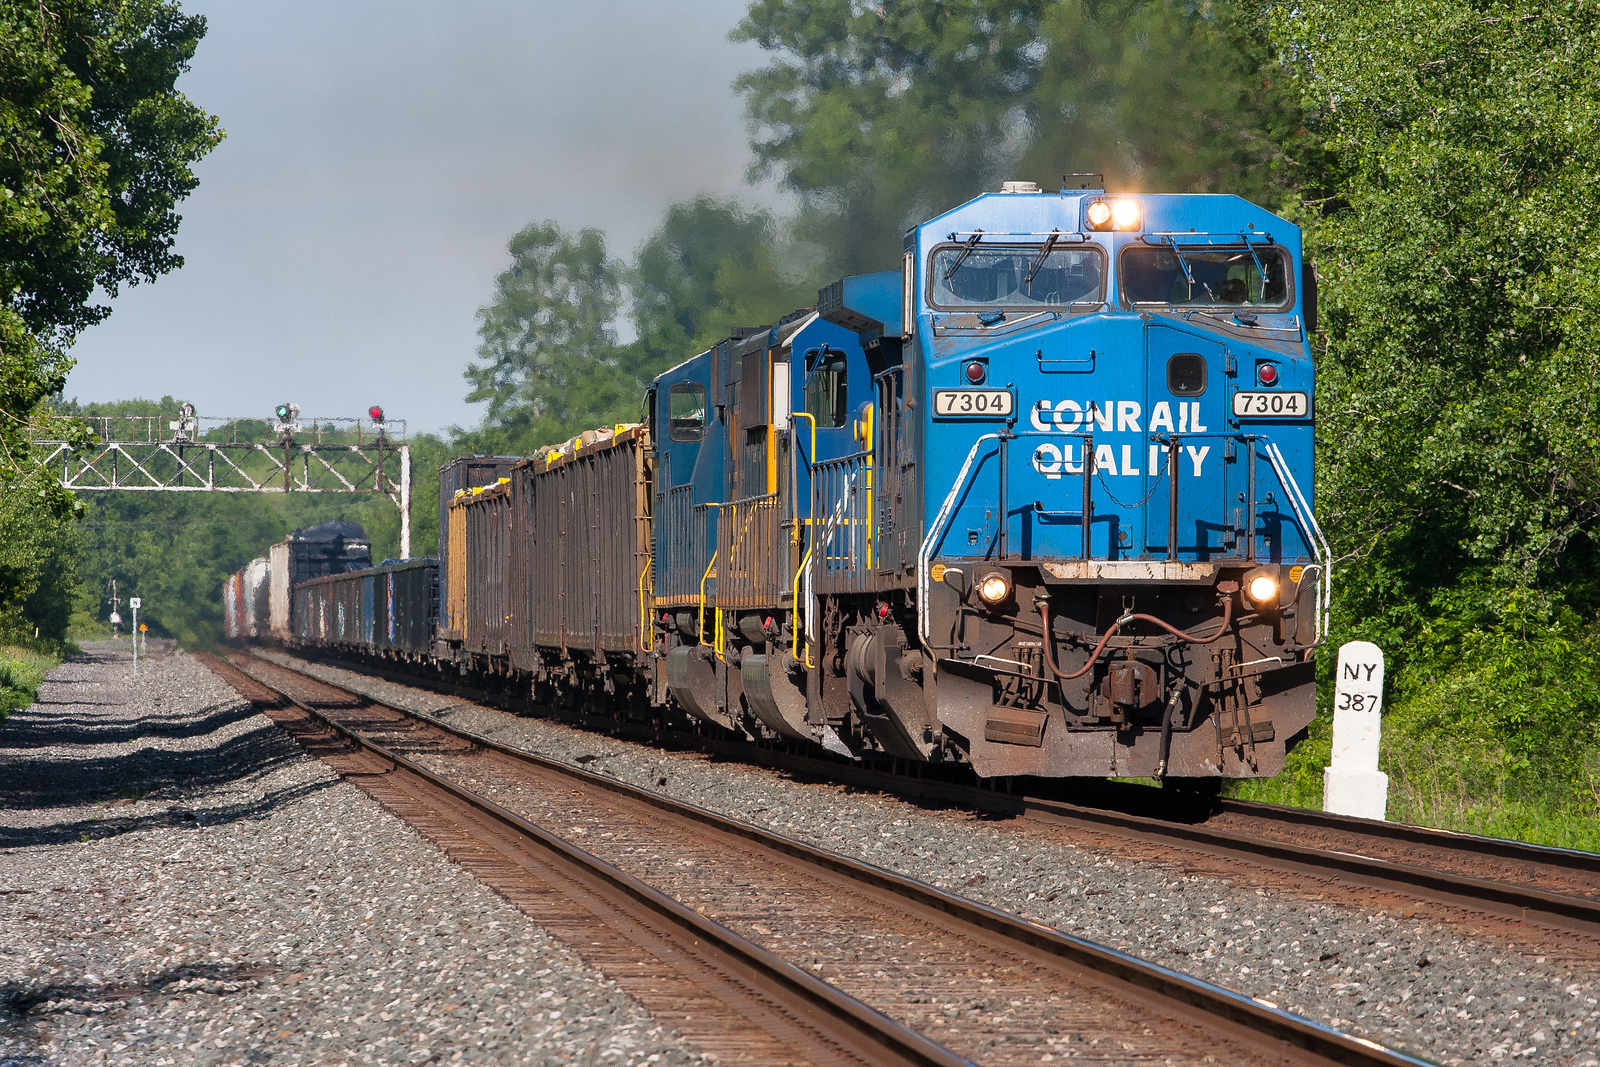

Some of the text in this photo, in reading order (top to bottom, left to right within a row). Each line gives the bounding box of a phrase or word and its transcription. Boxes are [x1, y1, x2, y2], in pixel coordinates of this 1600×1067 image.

[945, 394, 1003, 411] 7304
[1242, 395, 1298, 413] 7304
[1030, 400, 1207, 433] CONRAIL
[1344, 662, 1377, 681] NY
[1338, 693, 1378, 712] 387
